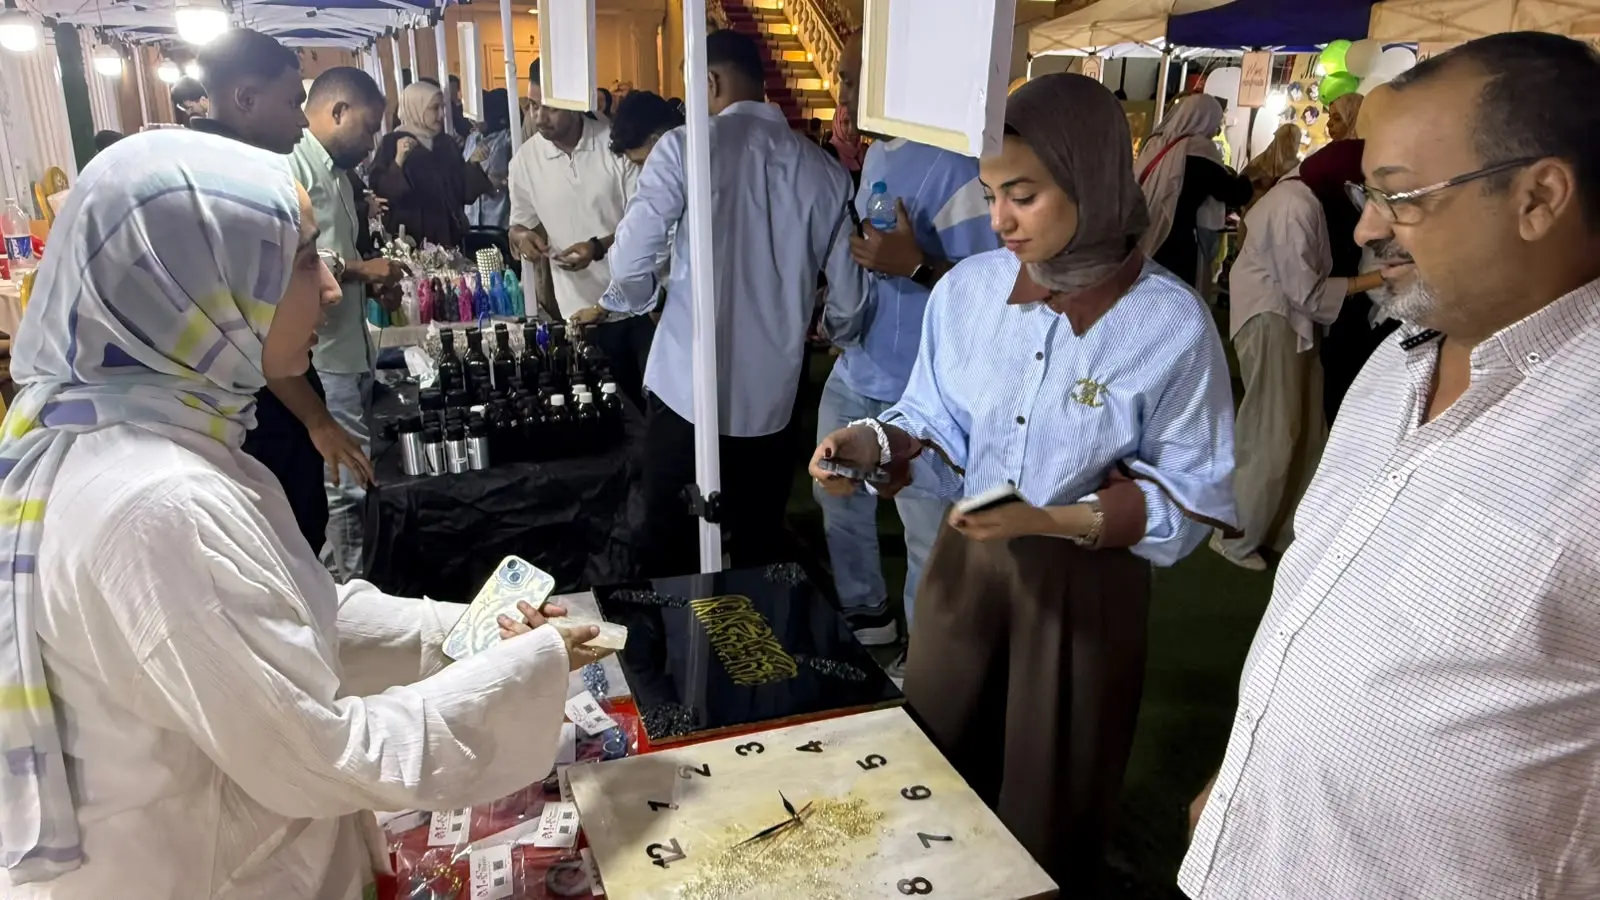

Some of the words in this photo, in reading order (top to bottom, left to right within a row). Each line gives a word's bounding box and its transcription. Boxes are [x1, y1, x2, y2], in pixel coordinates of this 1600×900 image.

[735, 741, 765, 756] 3
[795, 740, 823, 753] 4
[856, 754, 887, 770] 5
[678, 763, 711, 779] 2
[900, 785, 932, 801] 6
[647, 800, 679, 812] 1
[917, 832, 953, 849] 7
[646, 838, 687, 869] 12
[896, 876, 933, 896] 8
